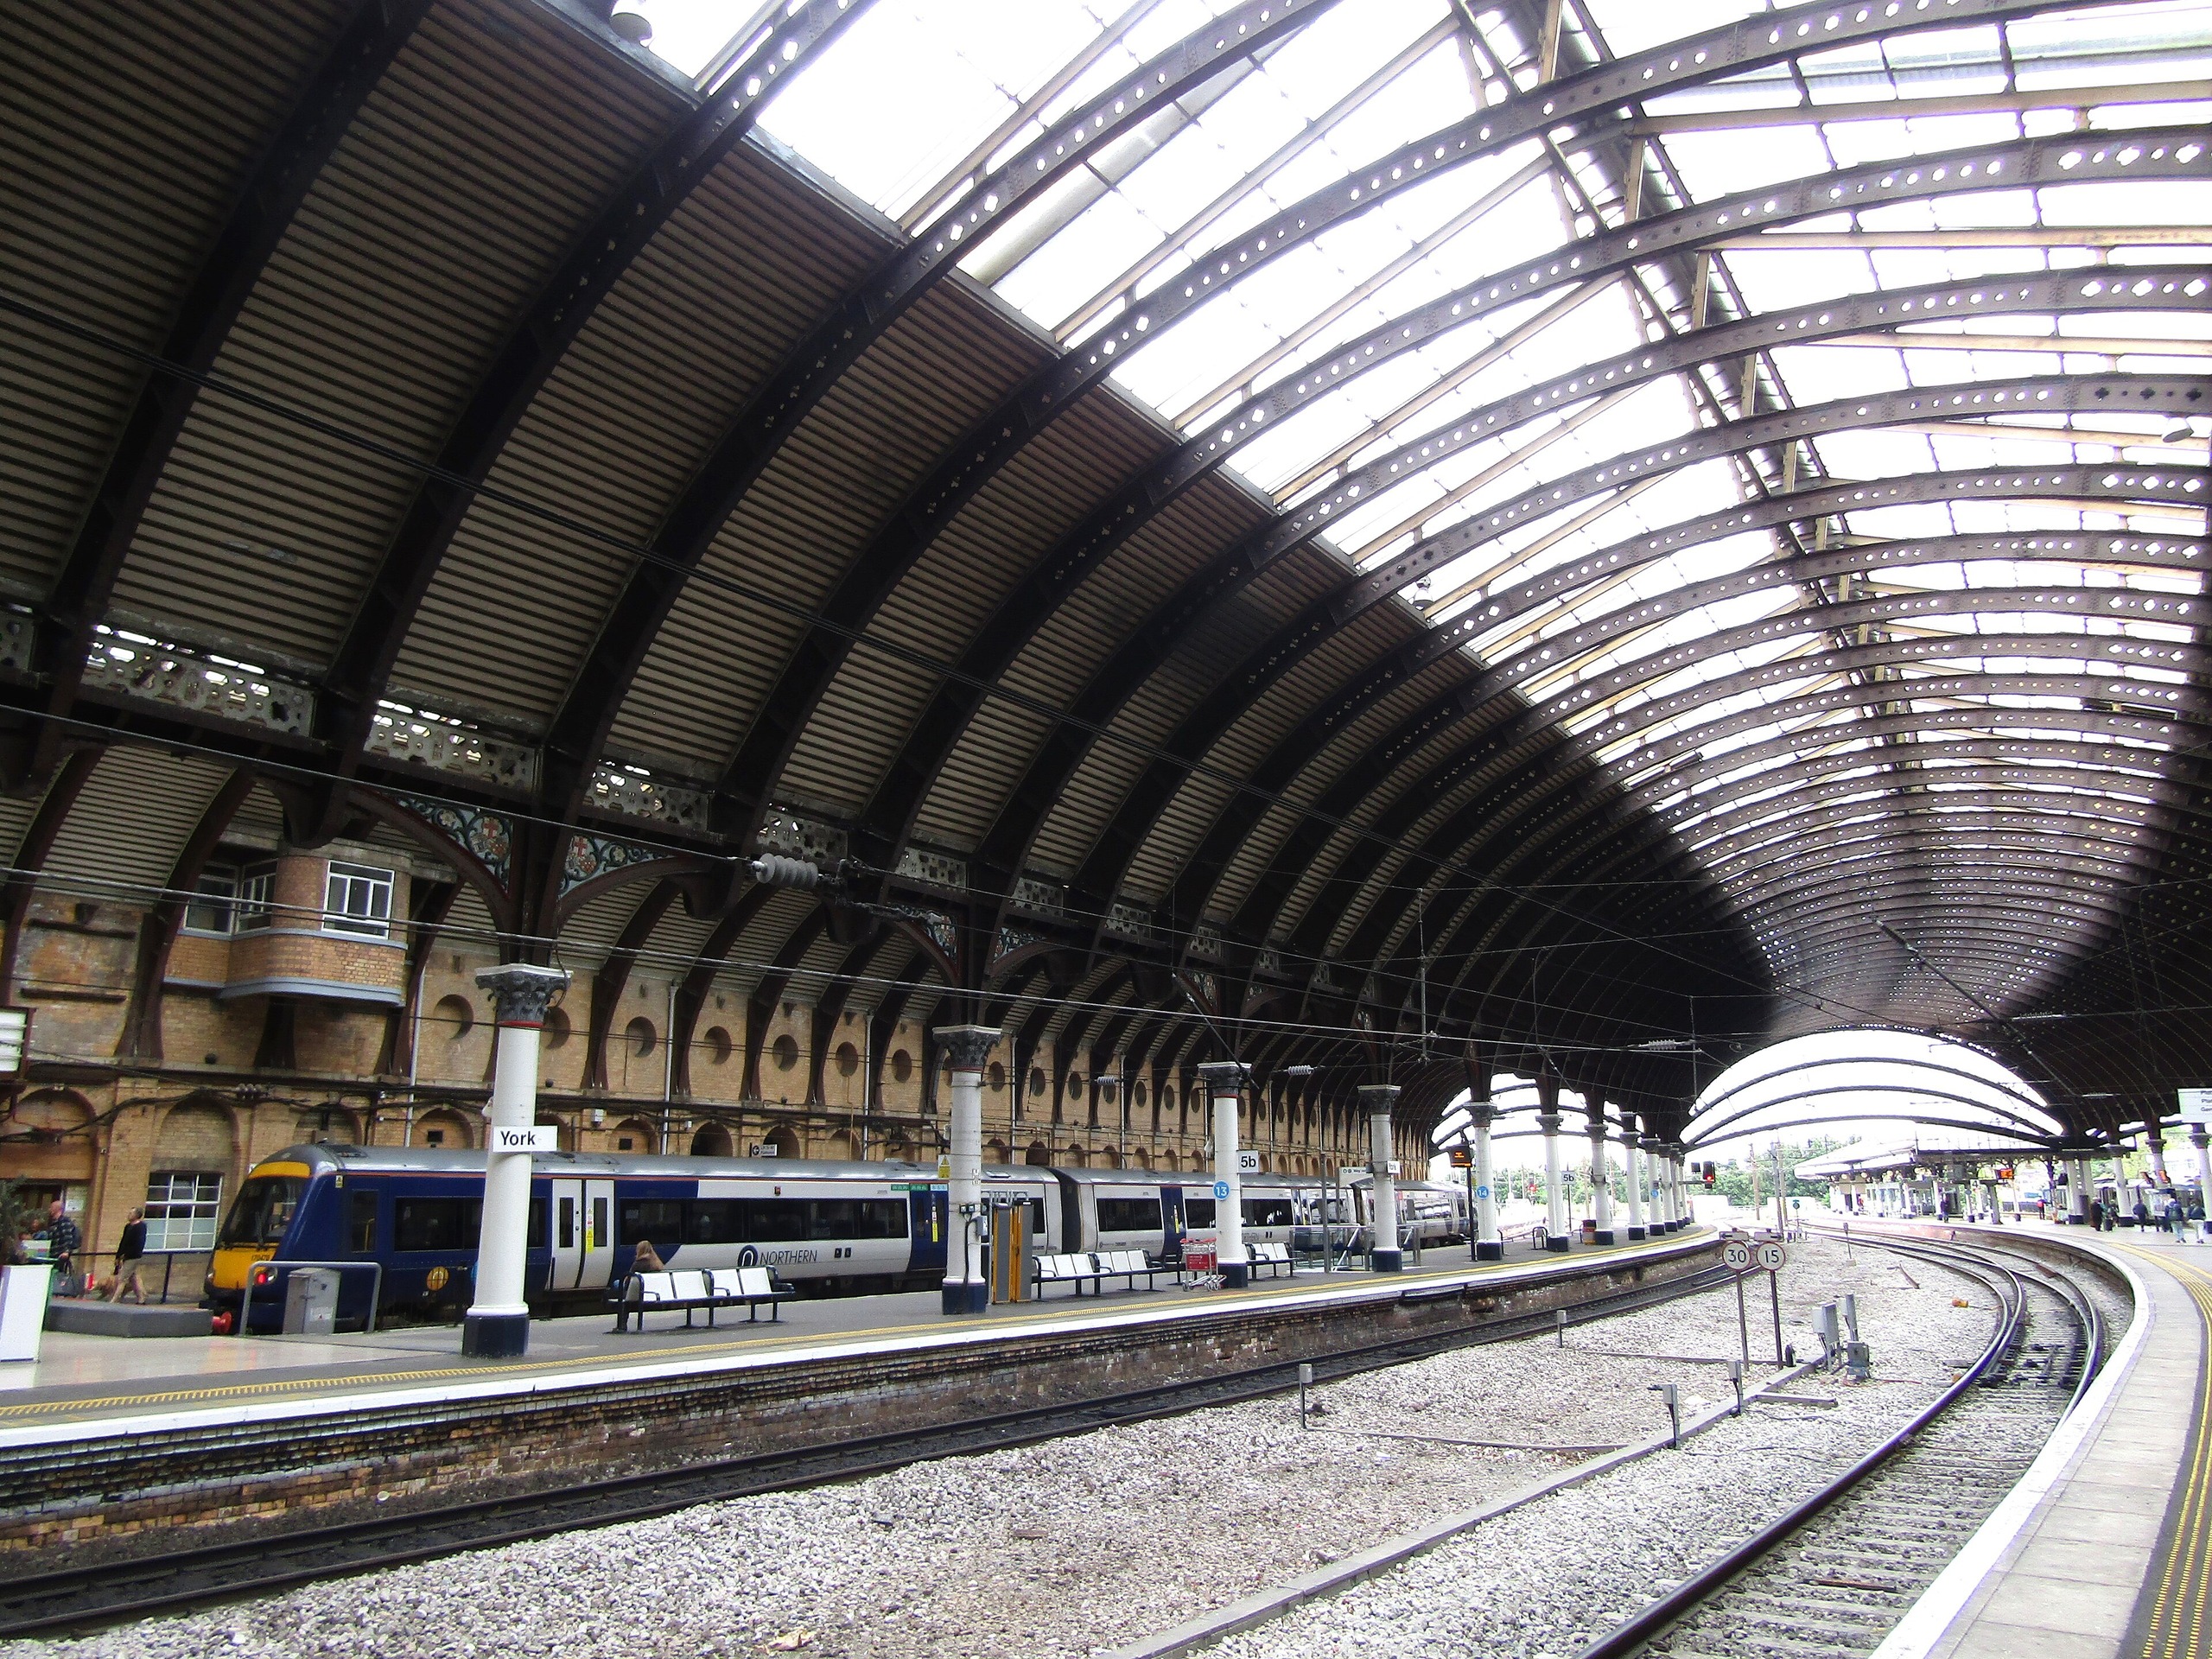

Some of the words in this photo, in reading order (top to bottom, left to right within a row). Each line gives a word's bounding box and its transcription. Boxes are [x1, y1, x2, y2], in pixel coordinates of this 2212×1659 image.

[500, 1130, 536, 1146] York
[1241, 1155, 1256, 1168] 5b
[1563, 1173, 1574, 1182] 5b
[1972, 1179, 1979, 1188] 4
[1216, 1186, 1227, 1197] 13
[760, 1249, 818, 1265] NORTHERN
[1727, 1249, 1747, 1263] 30
[1764, 1249, 1780, 1263] 15
